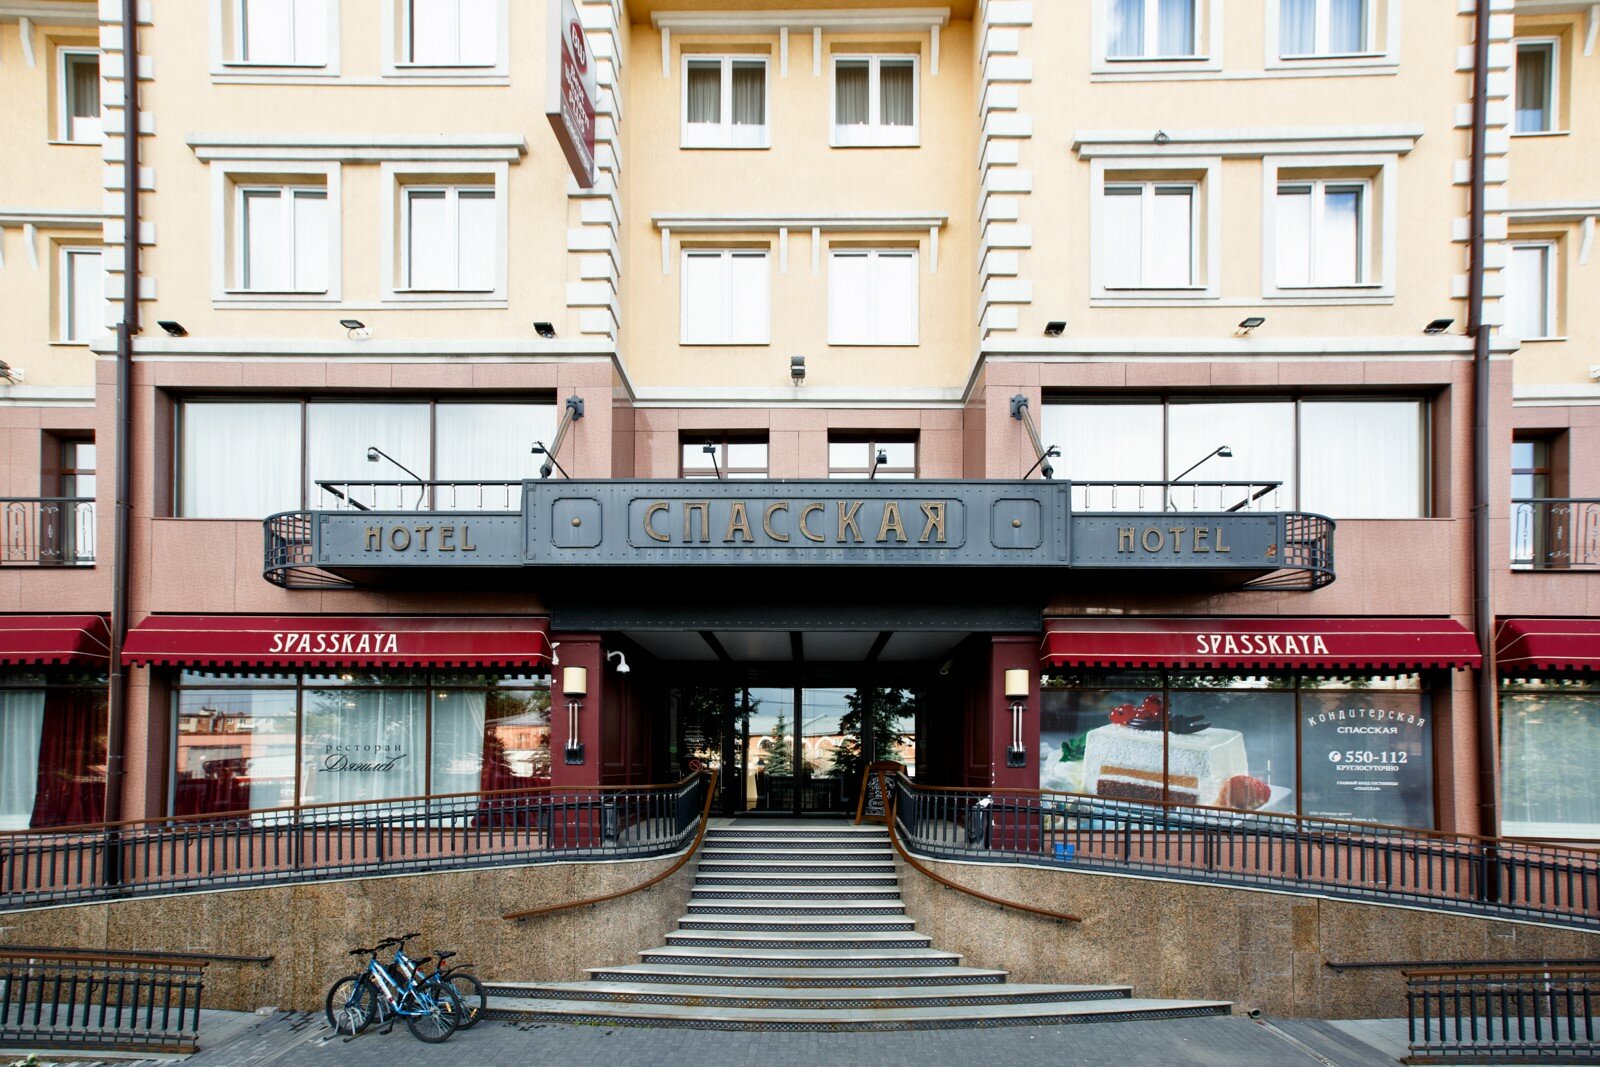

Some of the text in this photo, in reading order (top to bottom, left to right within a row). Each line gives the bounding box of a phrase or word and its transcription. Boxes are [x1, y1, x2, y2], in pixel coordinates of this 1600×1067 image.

[571, 24, 586, 66] BW
[643, 500, 948, 543] СПАССКАЯ
[364, 525, 477, 552] HOTEL
[1117, 526, 1231, 553] HOTEL
[268, 632, 398, 653] SPASSKAYA
[1196, 634, 1330, 655] SPASSKAYA
[1307, 708, 1426, 727] кондитерская
[1336, 726, 1398, 734] СПАССКАЯ
[325, 744, 402, 755] ресторан
[1344, 750, 1408, 764] 550-112
[1336, 764, 1400, 772] КРУГЛОСУТОЧНО
